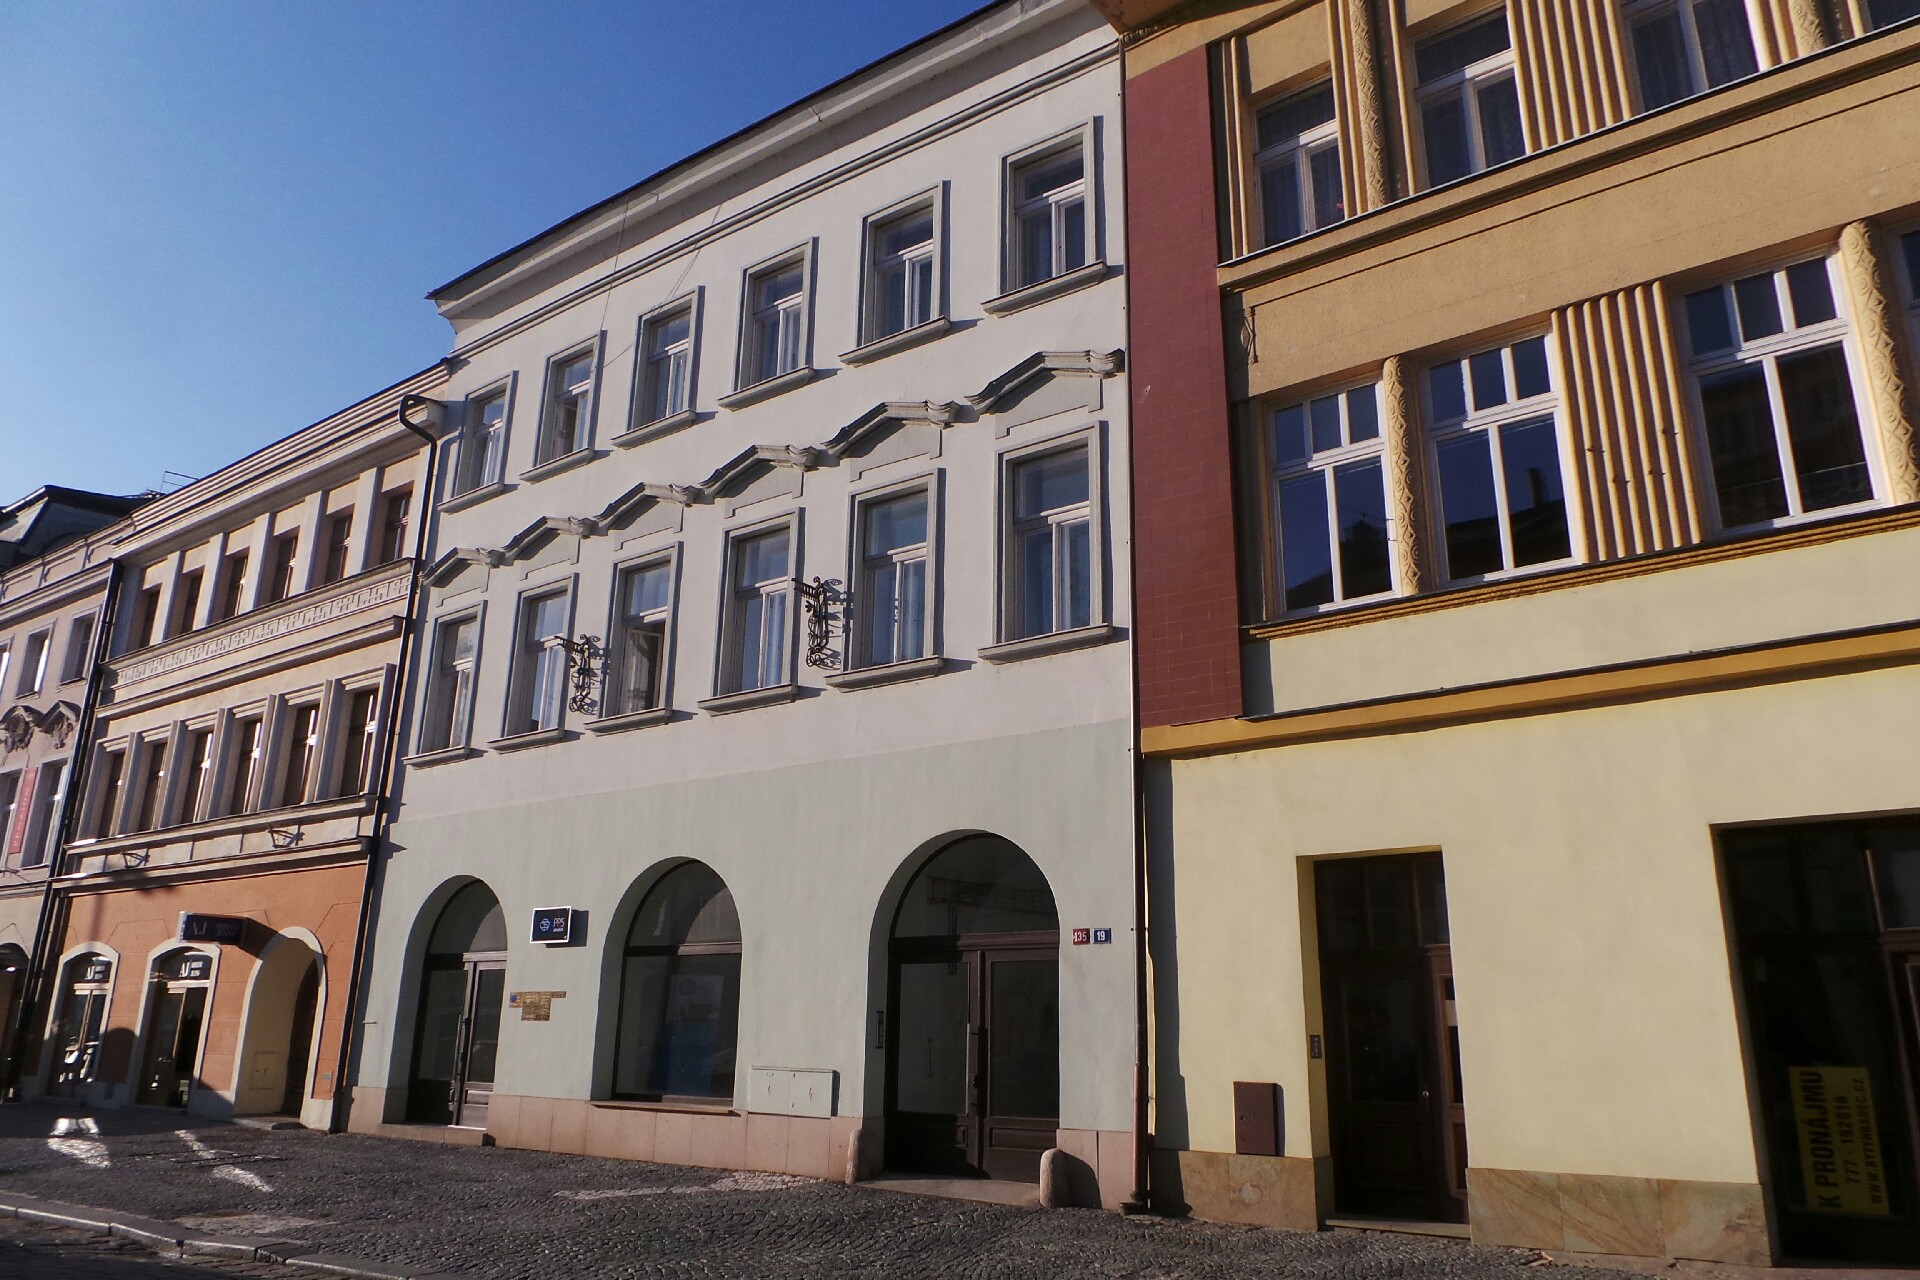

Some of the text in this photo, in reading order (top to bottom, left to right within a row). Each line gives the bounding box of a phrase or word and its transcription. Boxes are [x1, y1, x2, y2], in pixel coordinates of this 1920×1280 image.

[1074, 931, 1087, 942] 135
[1096, 930, 1106, 941] 19
[1800, 1071, 1842, 1208] K PRONÁJMU
[1843, 1159, 1860, 1185] 777
